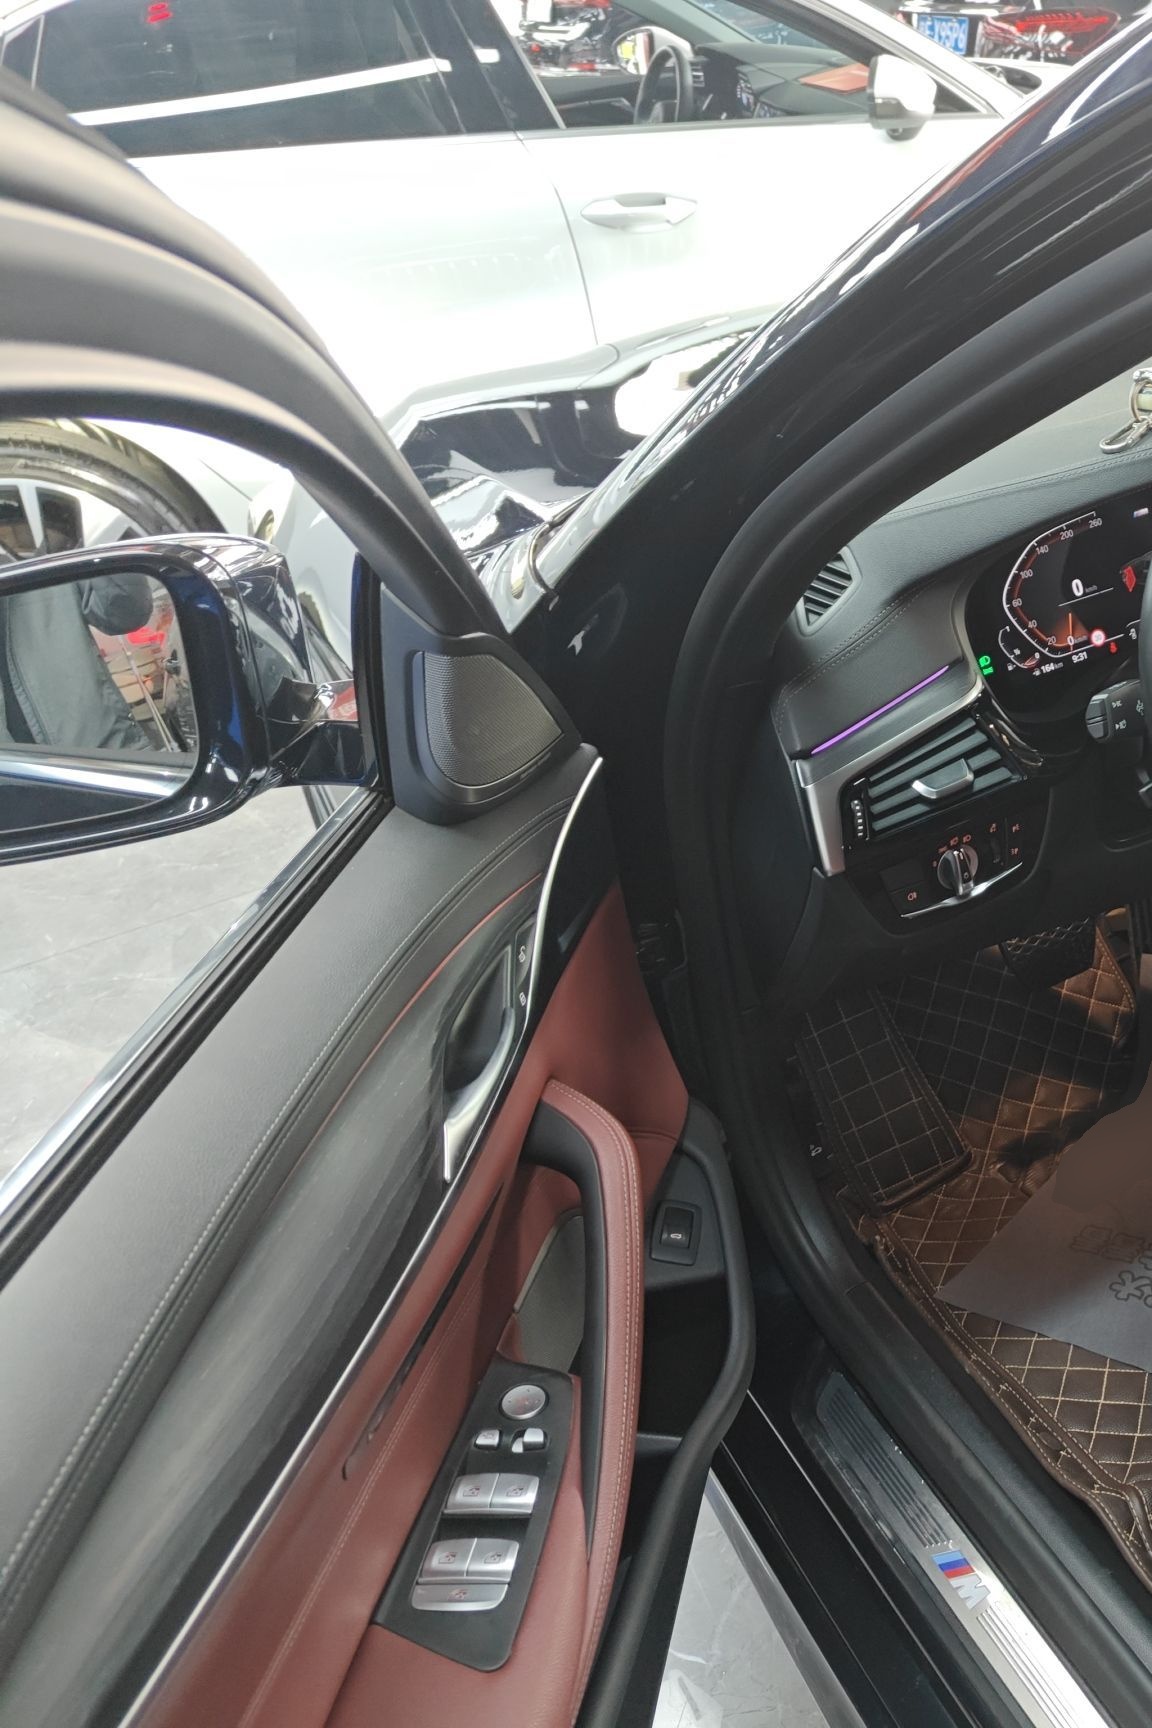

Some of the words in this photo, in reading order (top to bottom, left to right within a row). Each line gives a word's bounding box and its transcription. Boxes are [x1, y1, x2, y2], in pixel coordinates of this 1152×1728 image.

[1088, 518, 1103, 528] 260
[1060, 529, 1074, 540] 200
[1036, 544, 1049, 555] 140
[1020, 569, 1033, 579] 100
[1071, 578, 1084, 597] 0
[1012, 598, 1022, 607] 60
[1028, 619, 1038, 629] 40
[1047, 635, 1057, 646] 20
[1071, 651, 1088, 663] 9:31
[1041, 663, 1055, 674] 164
